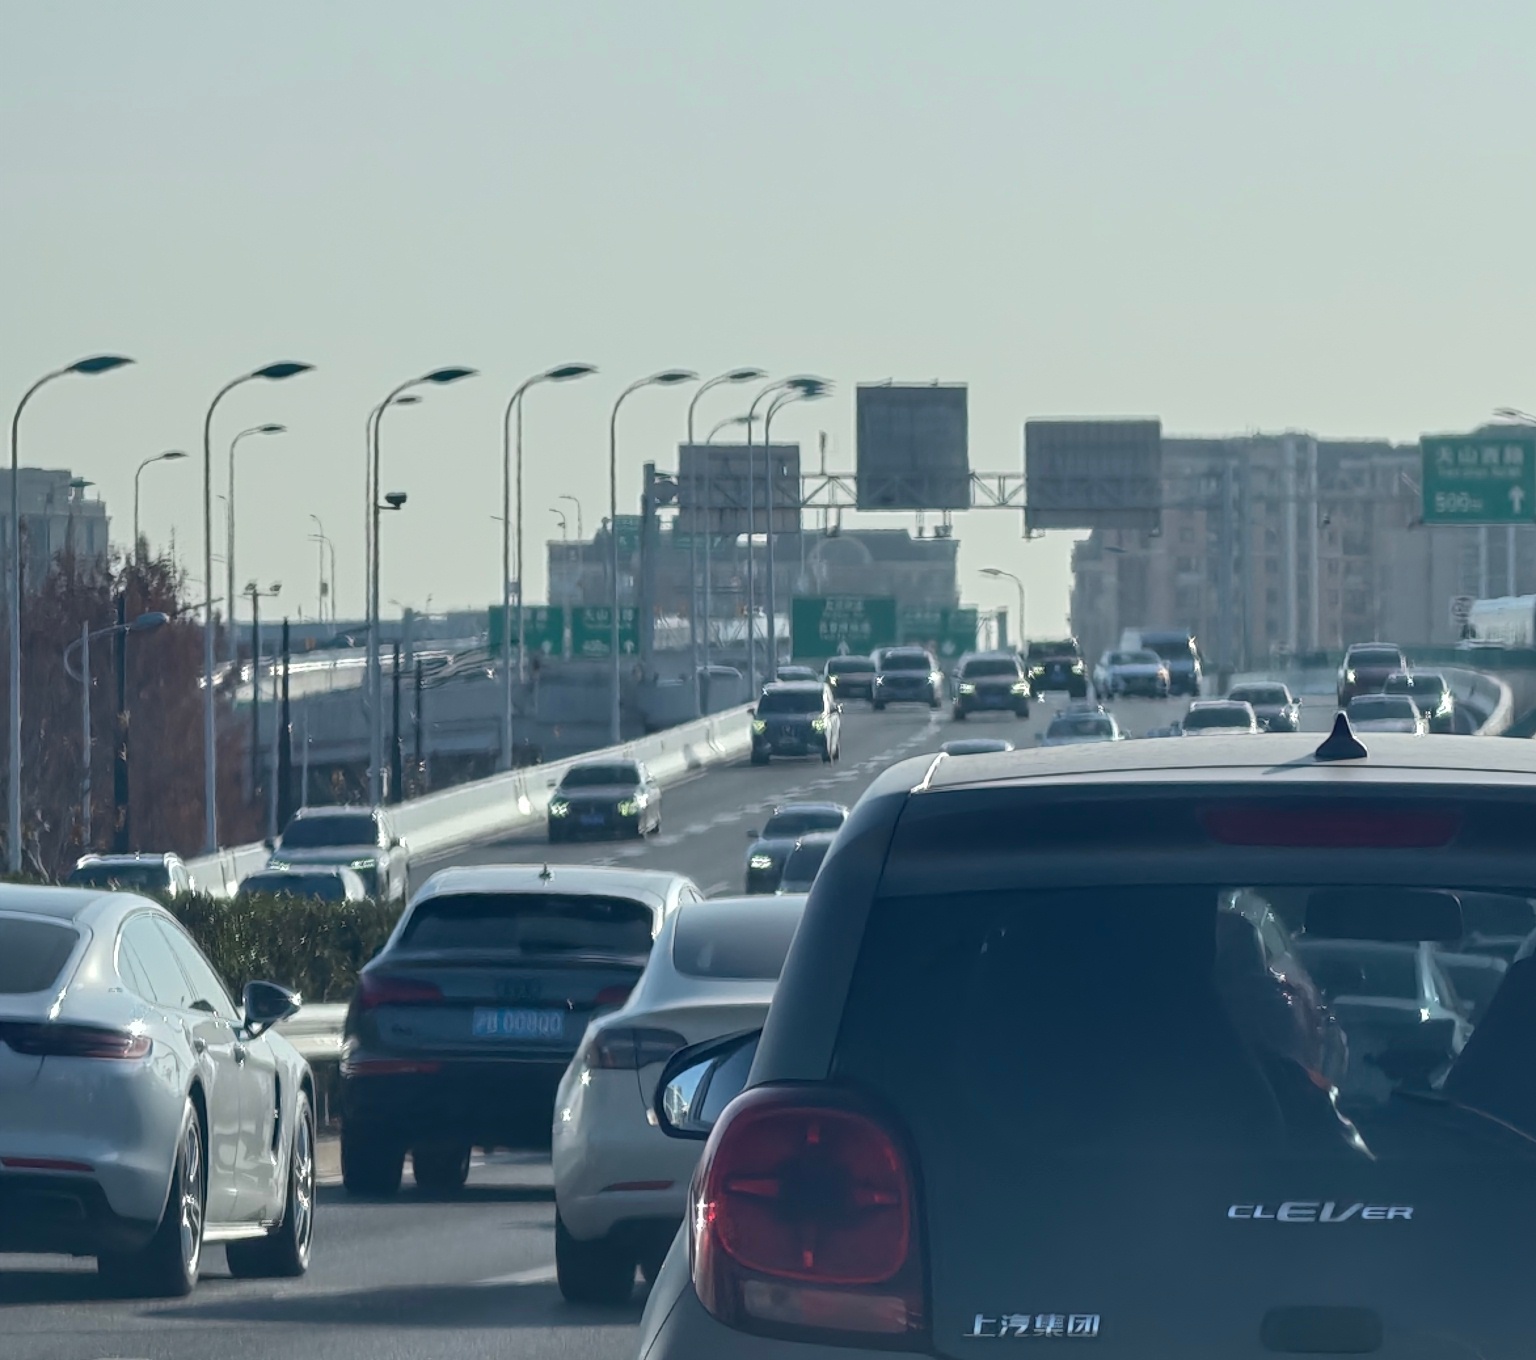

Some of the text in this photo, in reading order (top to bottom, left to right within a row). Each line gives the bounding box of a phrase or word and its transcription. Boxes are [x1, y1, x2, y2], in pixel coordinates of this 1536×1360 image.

[1227, 1200, 1414, 1224] CLEVER
[963, 1312, 1101, 1339] 上汽集团
